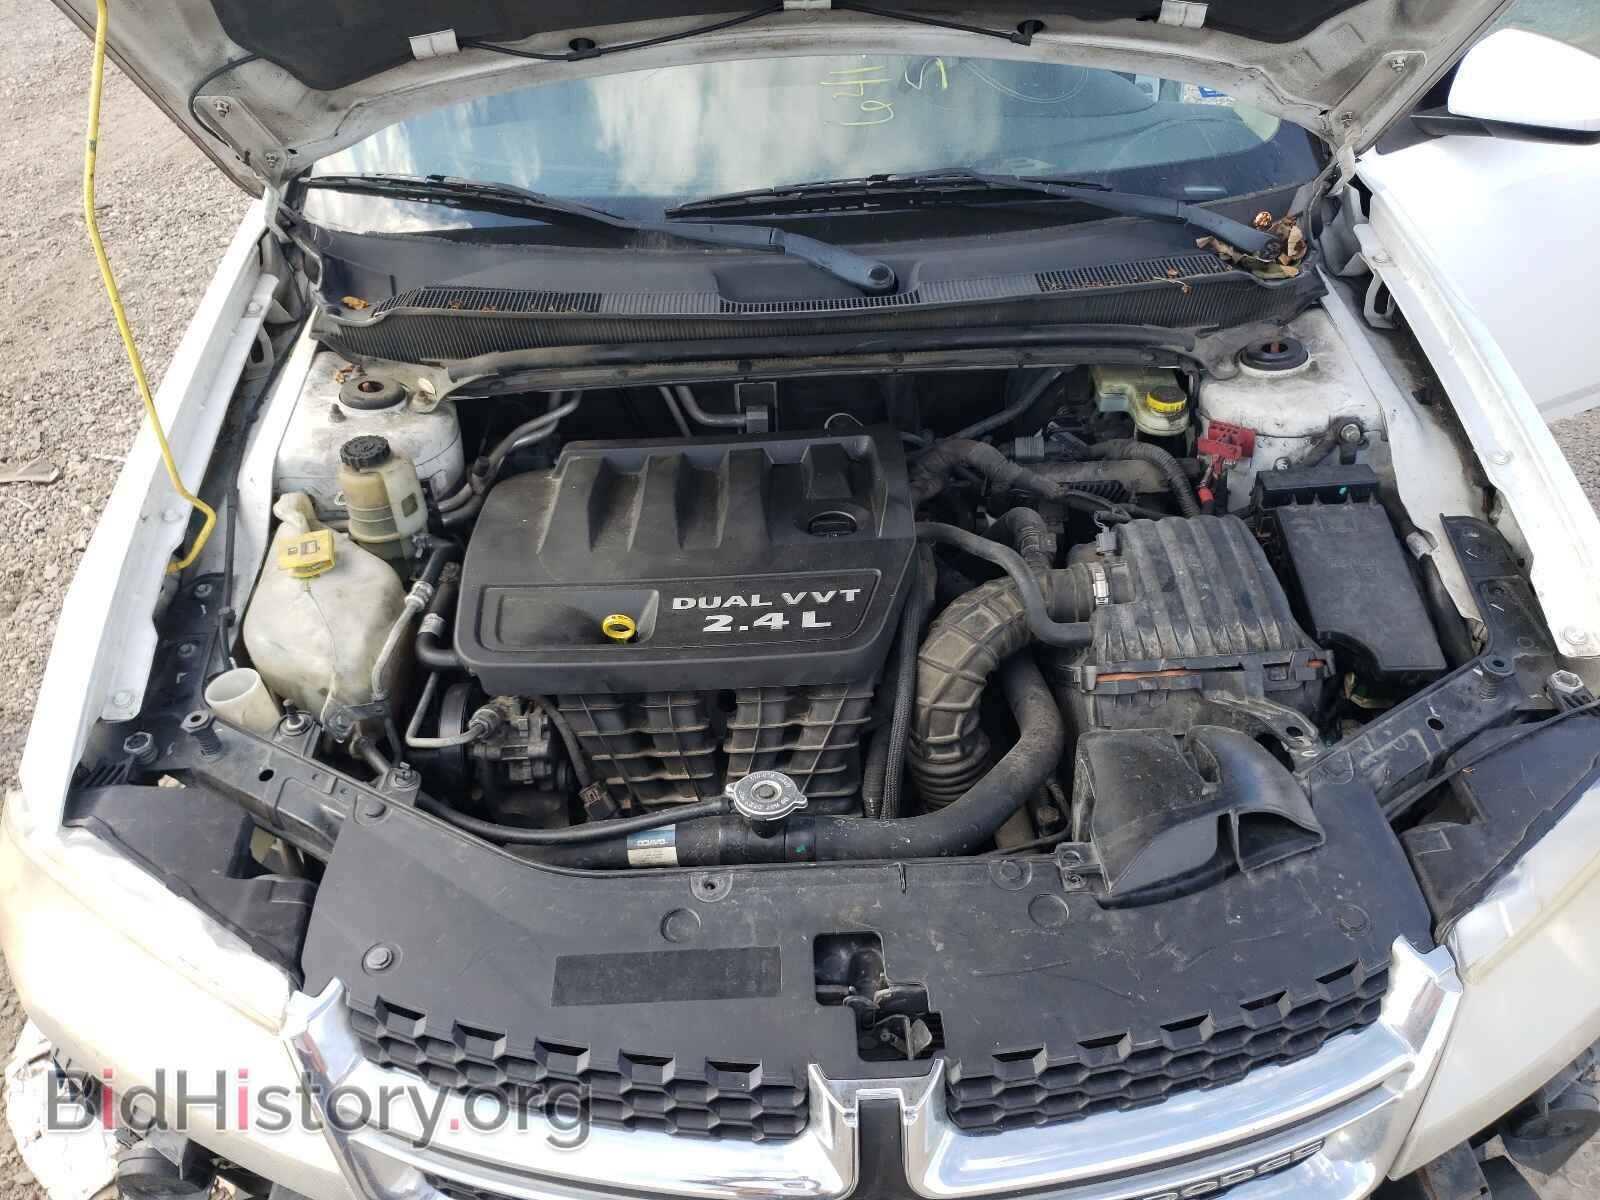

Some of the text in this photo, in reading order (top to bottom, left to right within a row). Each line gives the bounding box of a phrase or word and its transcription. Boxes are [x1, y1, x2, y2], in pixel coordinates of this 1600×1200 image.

[672, 588, 861, 610] DUAL VVT
[702, 610, 832, 632] 2.4 L
